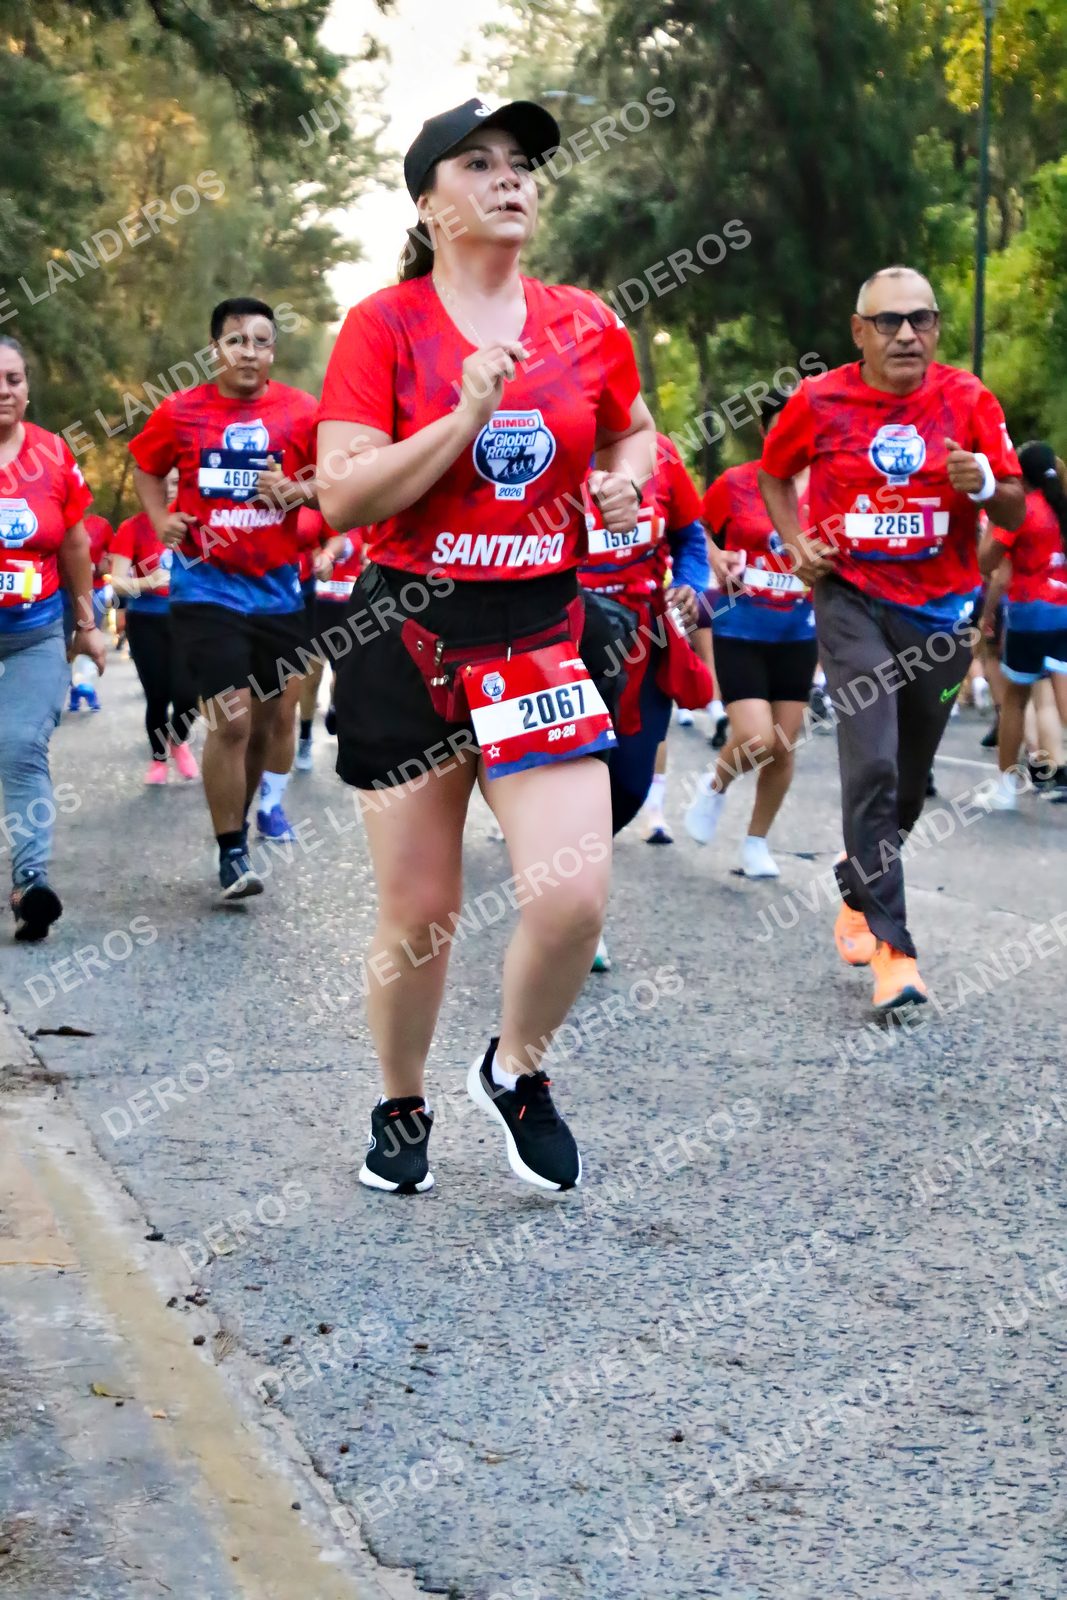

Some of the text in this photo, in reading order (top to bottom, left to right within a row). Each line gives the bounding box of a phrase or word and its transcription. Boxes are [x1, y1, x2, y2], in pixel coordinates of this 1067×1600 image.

[493, 419, 535, 428] BIMBO
[494, 432, 537, 448] Global
[486, 446, 520, 459] Race
[224, 471, 259, 486] 4602
[498, 487, 522, 497] 2026
[874, 515, 920, 535] 2265
[432, 532, 564, 567] SANTIAGO
[767, 573, 793, 589] 3177
[518, 684, 586, 730] 2067
